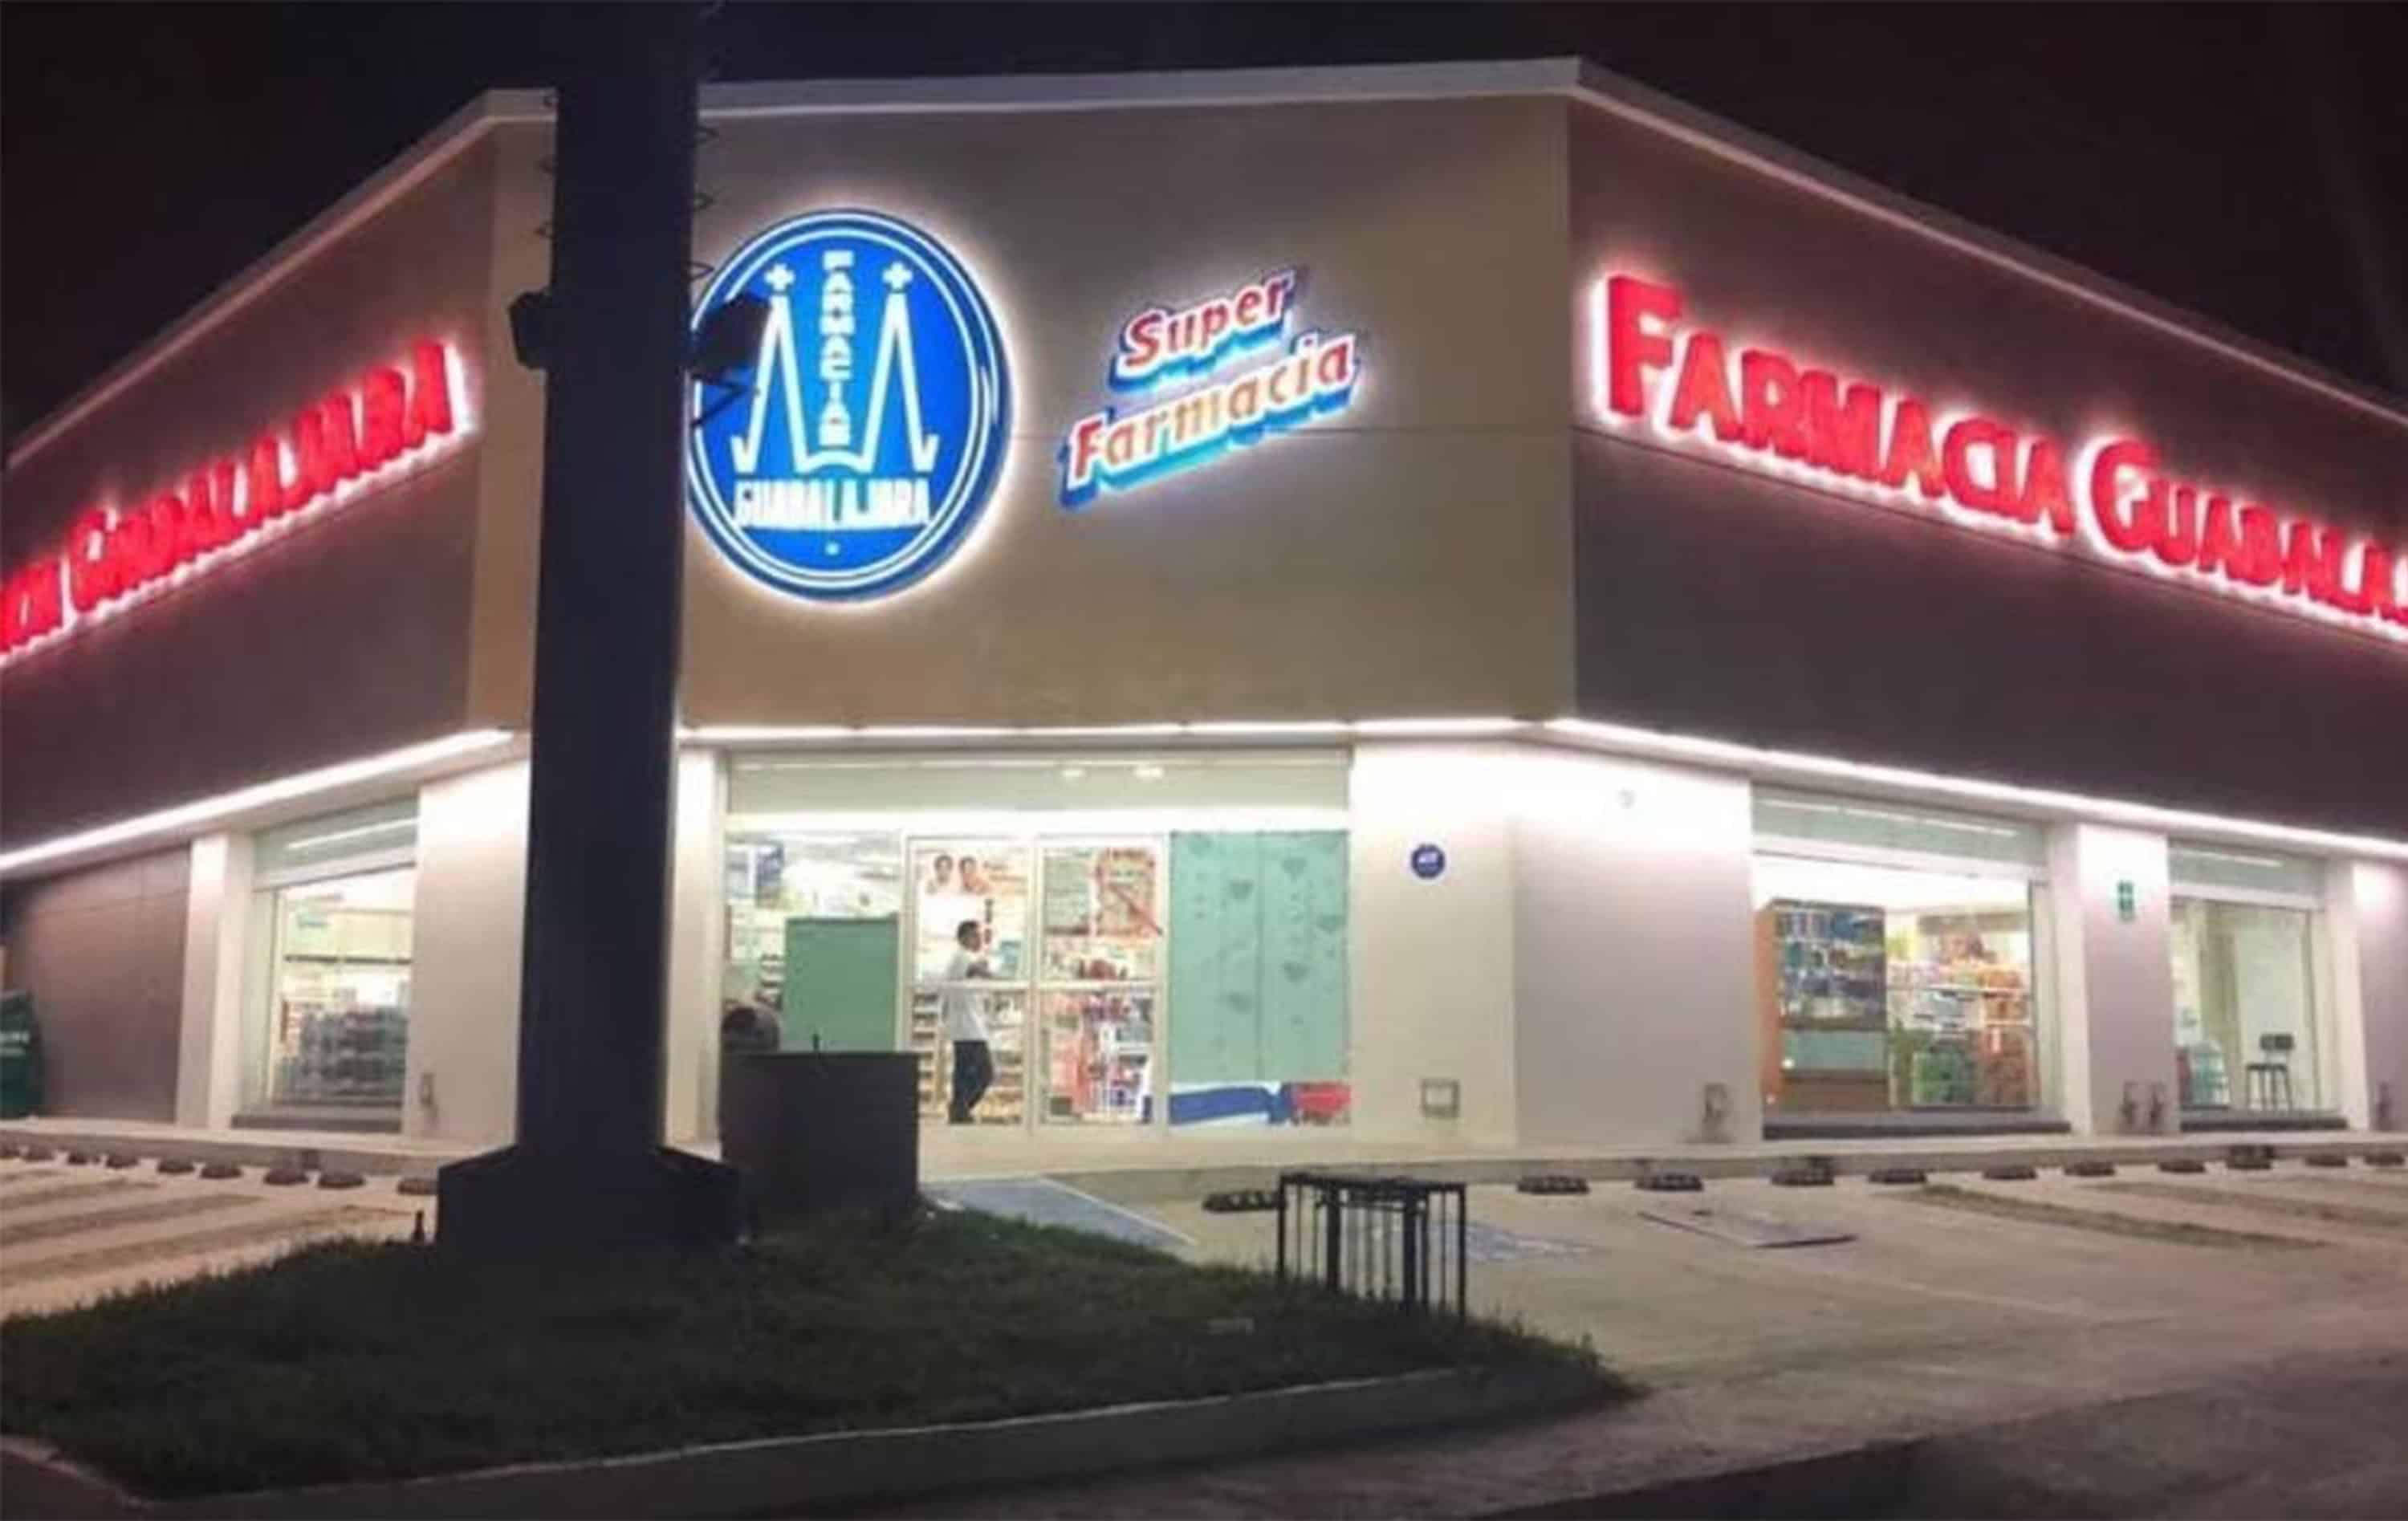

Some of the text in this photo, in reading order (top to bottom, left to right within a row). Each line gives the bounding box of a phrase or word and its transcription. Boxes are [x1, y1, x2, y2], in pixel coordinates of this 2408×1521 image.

[1120, 273, 1294, 376] Super
[1070, 337, 1355, 486] Farmacia
[1607, 275, 2076, 535] FARMACIA
